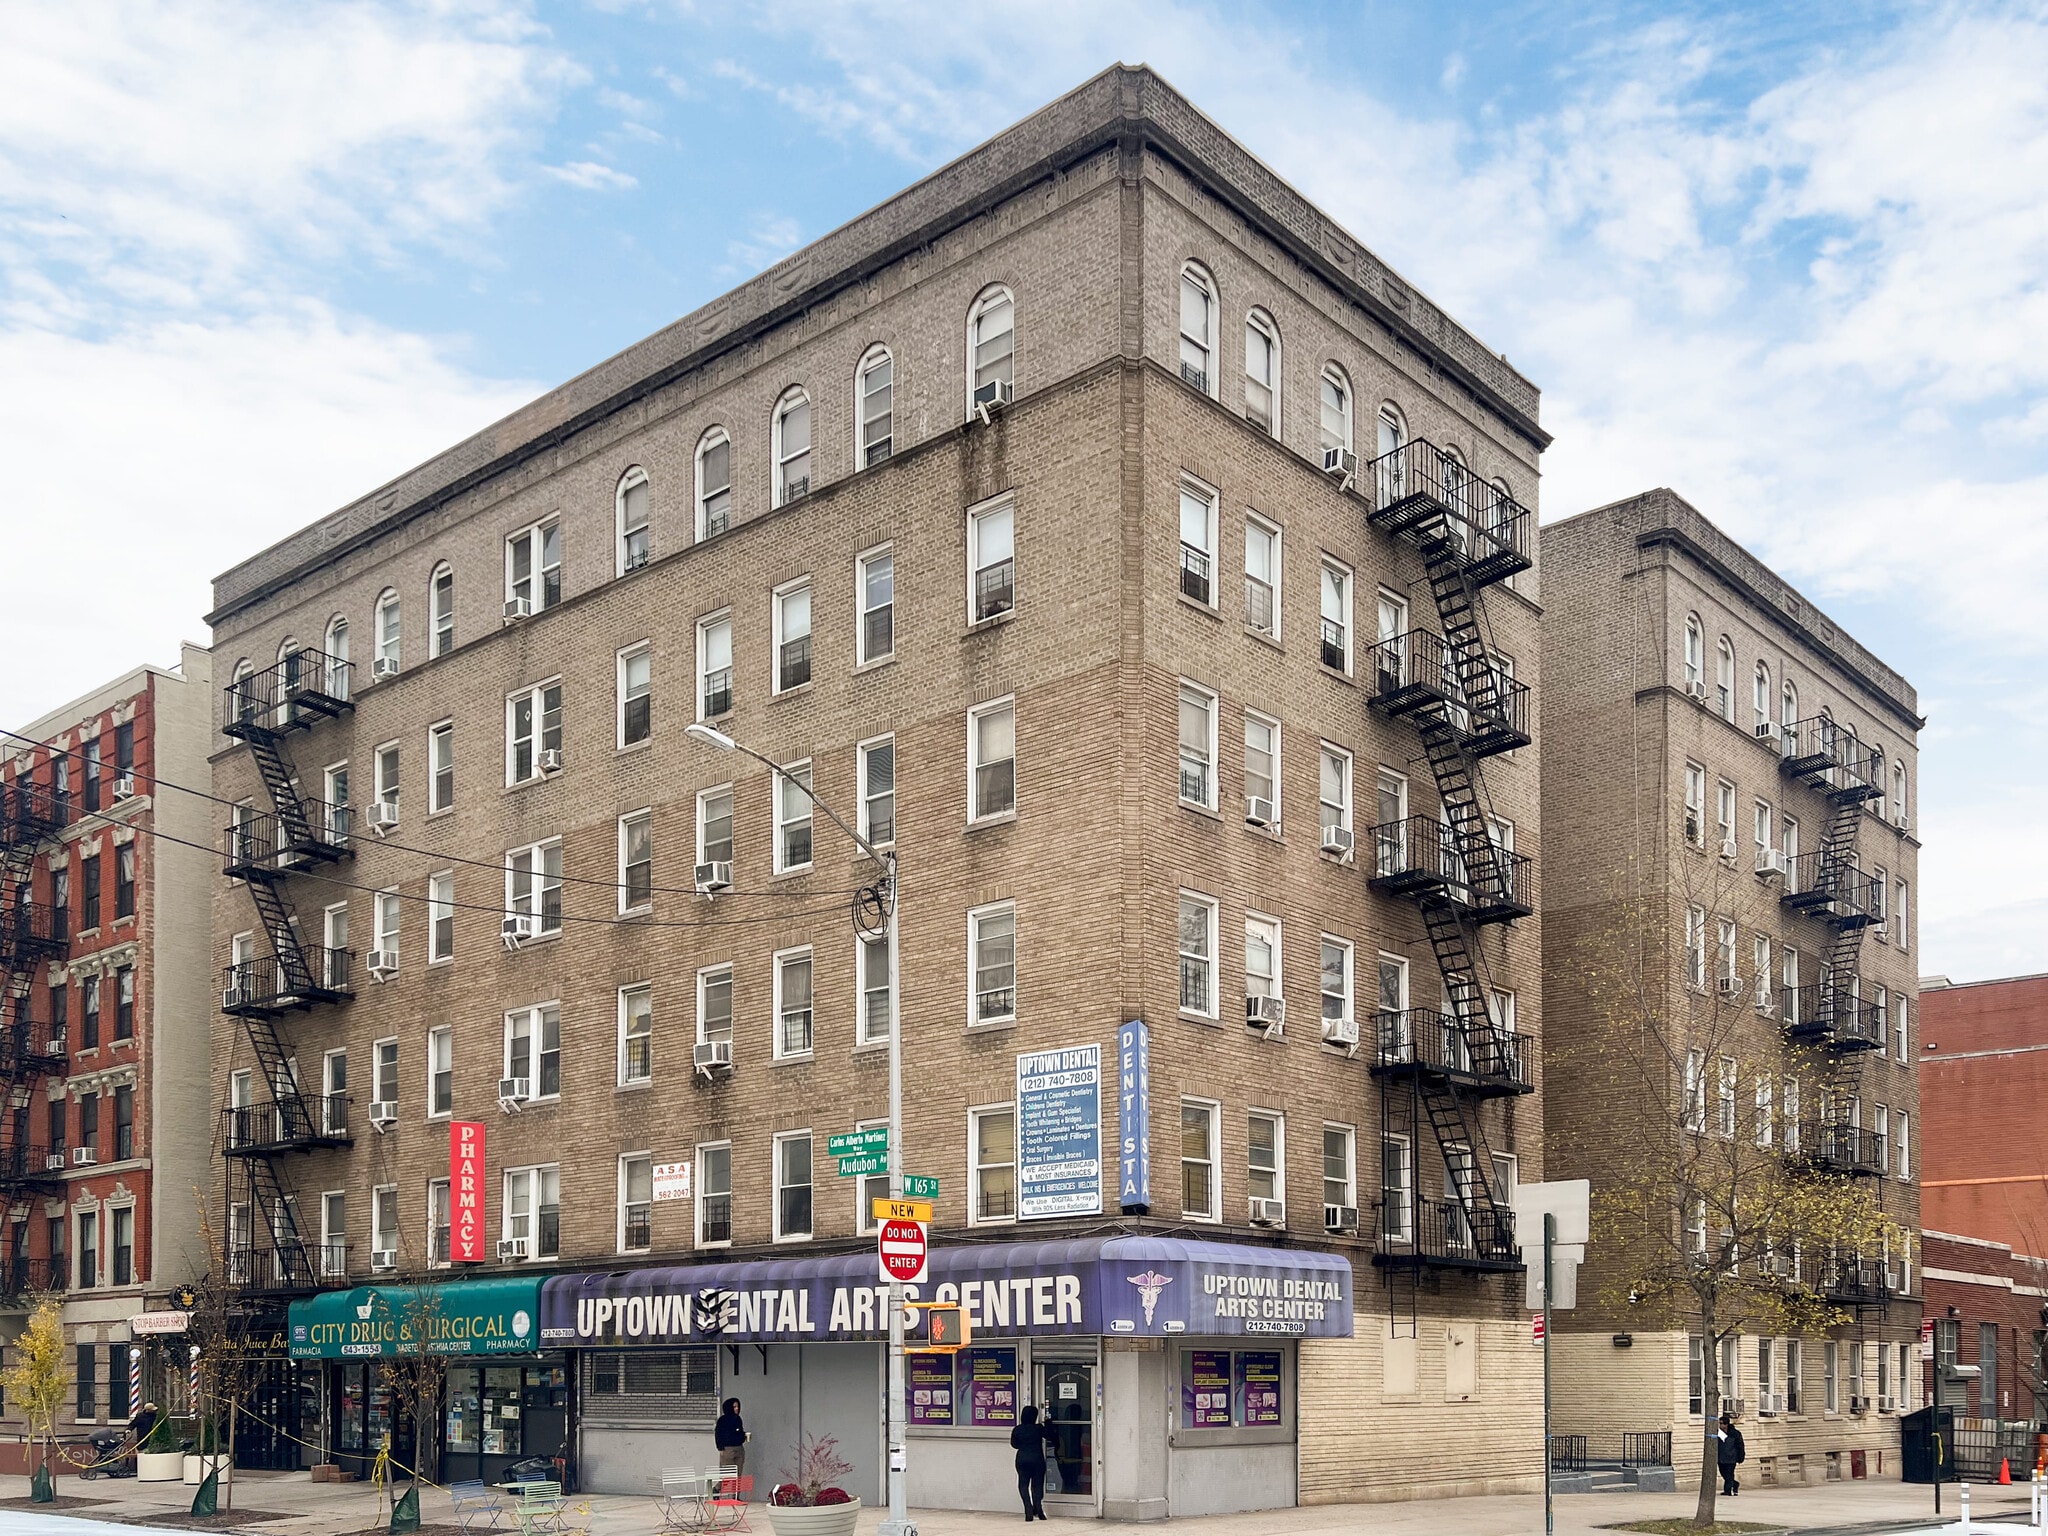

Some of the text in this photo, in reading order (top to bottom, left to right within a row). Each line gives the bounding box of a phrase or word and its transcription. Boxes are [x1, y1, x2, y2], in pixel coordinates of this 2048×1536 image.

[1021, 1048, 1097, 1075] UPTOWN DENTAL
[1024, 1071, 1093, 1090] (212) 740-7808
[1025, 1093, 1042, 1102] General
[1049, 1091, 1070, 1099] Cosmetic
[1071, 1088, 1093, 1096] Dentistry
[1046, 1100, 1066, 1108] Dentistry
[1122, 1031, 1138, 1197] DENTISTA
[1140, 1030, 1149, 1196] DENTISTA
[830, 1132, 885, 1148] Carlos Alberto Martinez
[1045, 1134, 1068, 1142] Colored
[1070, 1132, 1091, 1140] Fillings
[841, 1158, 877, 1173] Audubon
[1038, 1164, 1062, 1172] ACCEPT
[1064, 1161, 1094, 1169] MEDICAID
[1054, 1169, 1091, 1178] INSURANCES
[459, 1126, 476, 1257] PHARMACY
[904, 1177, 911, 1191] W
[914, 1178, 927, 1193] 165
[1052, 1195, 1074, 1203] DIGITAL
[1076, 1195, 1095, 1203] X-rays
[891, 1204, 915, 1217] NEW
[887, 1228, 918, 1239] DO NOT
[889, 1257, 917, 1268] ENTER
[1203, 1274, 1342, 1301] UPTOWN DENTAL
[577, 1294, 692, 1337] UPTOWN
[828, 1284, 921, 1332] ARTS
[936, 1275, 1082, 1328] CENTER
[1215, 1297, 1325, 1320] ARTS CENTER
[1111, 1321, 1117, 1329] 1
[1164, 1322, 1169, 1330] 1
[1248, 1322, 1304, 1331] 212-740-7808
[310, 1323, 345, 1344] CITY
[351, 1321, 394, 1342] DRUG
[400, 1323, 413, 1340] &
[240, 1333, 268, 1352] Juice
[449, 1341, 471, 1350] CENTER
[487, 1338, 531, 1349] PHARMACY
[292, 1347, 322, 1356] FARMACIA
